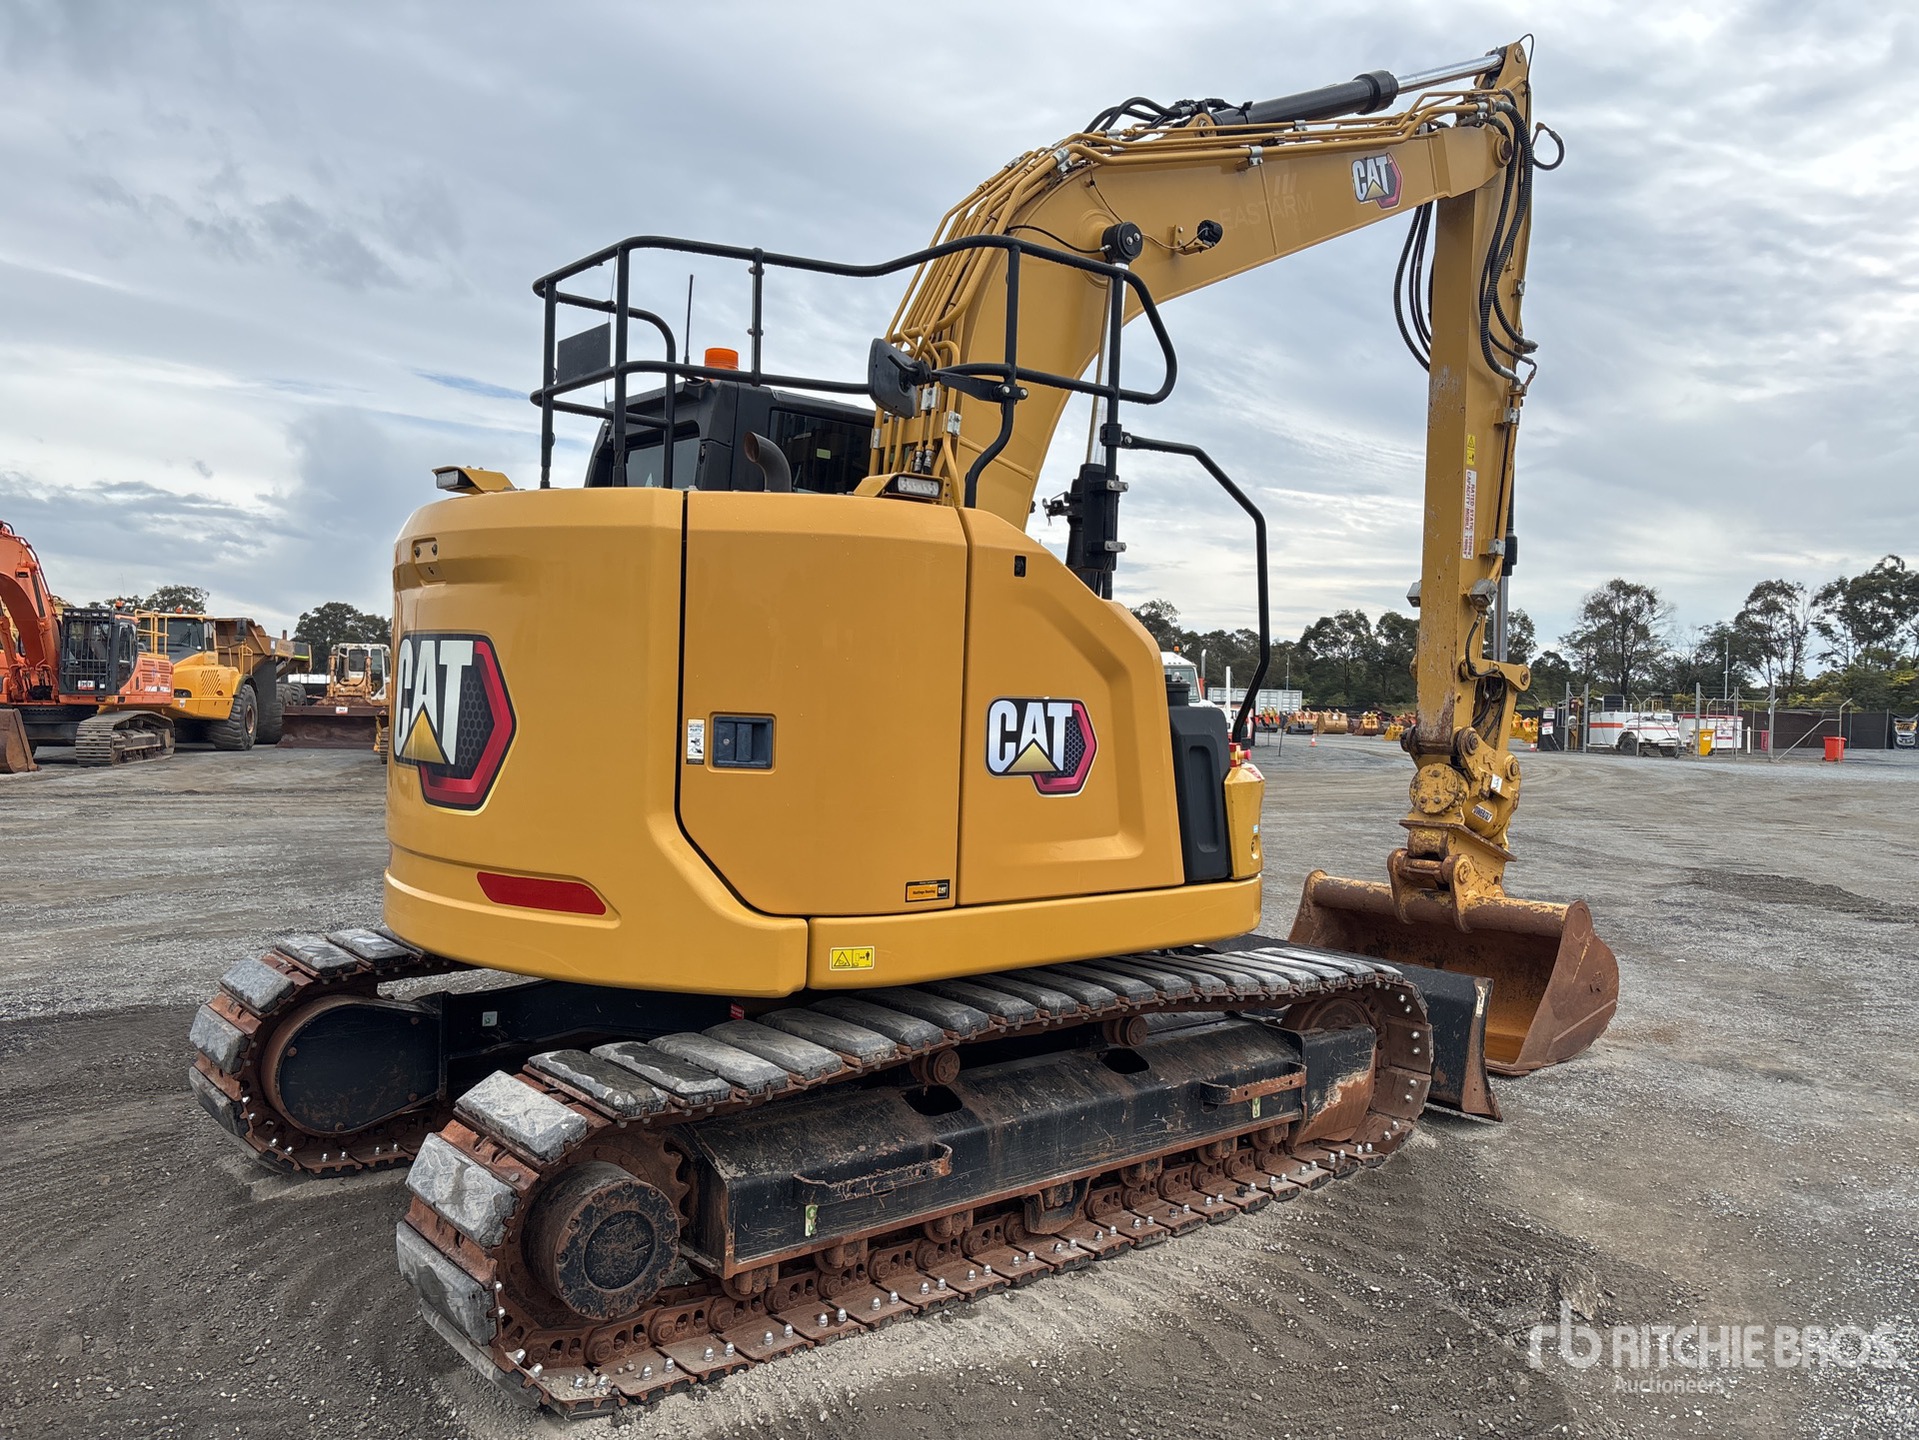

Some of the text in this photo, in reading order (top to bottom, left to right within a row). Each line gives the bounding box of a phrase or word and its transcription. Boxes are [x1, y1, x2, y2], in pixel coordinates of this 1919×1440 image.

[1352, 156, 1389, 202] CAT
[395, 639, 474, 765] CAT
[989, 700, 1073, 773] CAT
